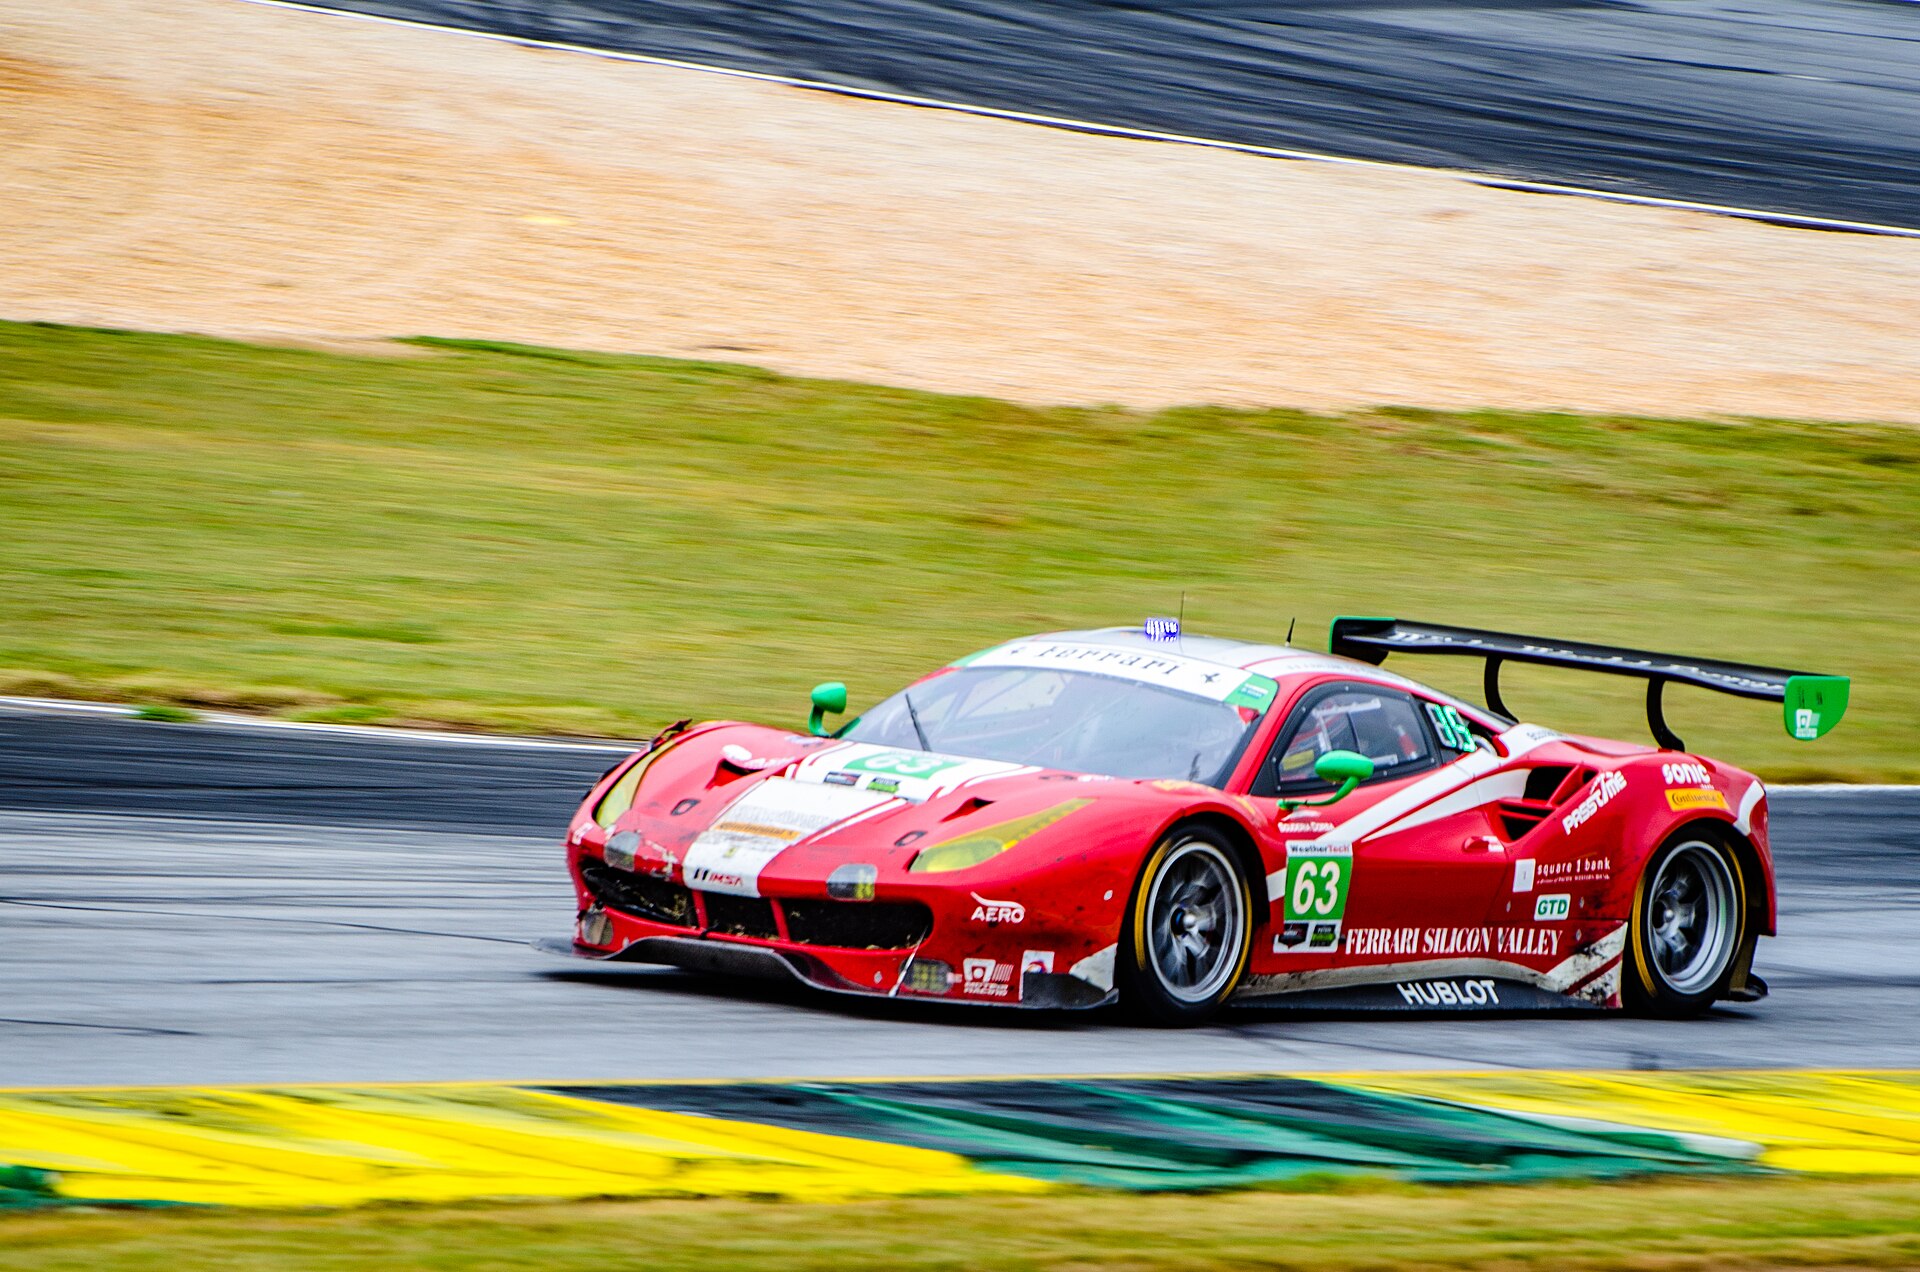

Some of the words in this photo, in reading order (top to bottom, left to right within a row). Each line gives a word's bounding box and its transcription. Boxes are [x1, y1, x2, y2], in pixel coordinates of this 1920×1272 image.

[1036, 645, 1183, 675] Ferrari
[864, 752, 943, 773] 63
[1291, 845, 1349, 853] WeatherTech
[1537, 862, 1572, 877] square
[1576, 859, 1582, 873] 1
[1584, 857, 1611, 871] bank
[708, 872, 744, 887] IMSA
[1292, 861, 1341, 915] 63
[971, 906, 1025, 923] AERO
[1537, 900, 1567, 915] GTD
[1345, 927, 1420, 955] FERRARI
[1422, 927, 1493, 954] SILICON
[1497, 927, 1563, 955] VALLEY
[1397, 980, 1499, 1005] HUBLOT
